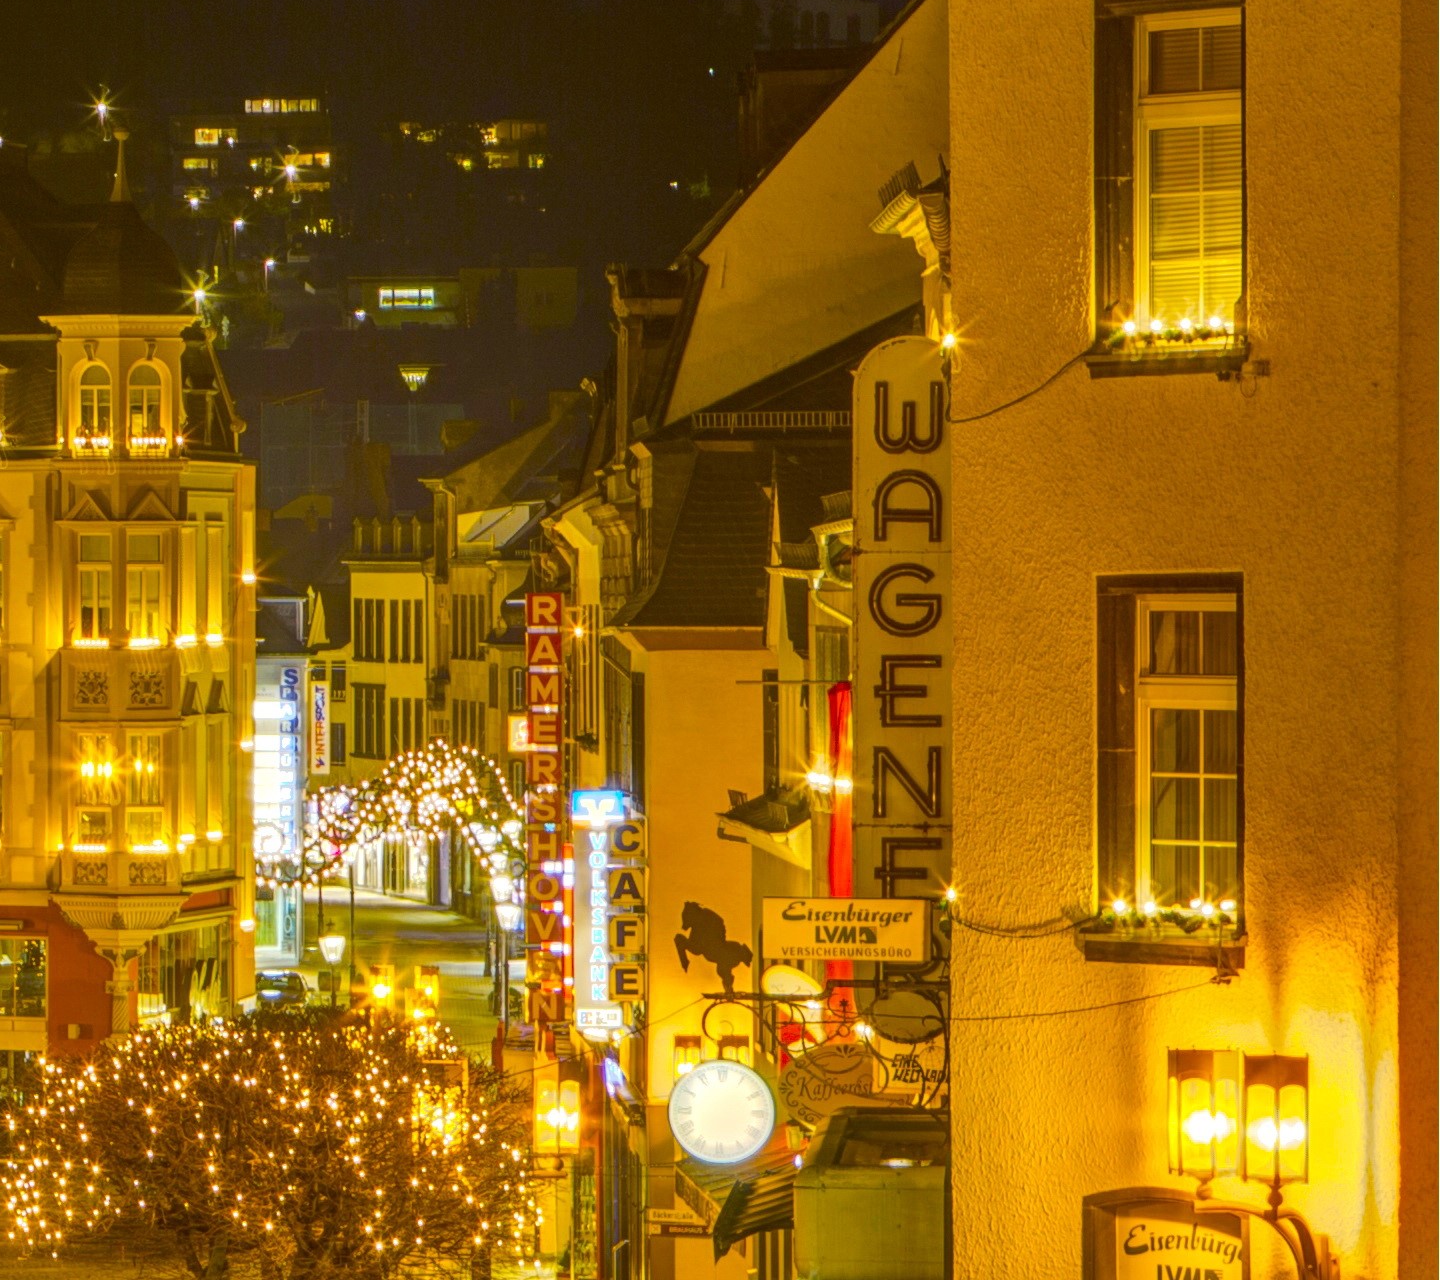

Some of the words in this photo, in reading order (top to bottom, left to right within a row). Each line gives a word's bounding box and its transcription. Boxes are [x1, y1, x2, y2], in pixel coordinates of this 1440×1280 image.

[588, 831, 608, 1002] VOLKSBANK
[781, 901, 913, 927] Eisenbürger
[815, 925, 857, 944] LVM
[781, 946, 912, 958] VERSICHERUNGSBÜRO
[891, 1053, 920, 1068] EINE
